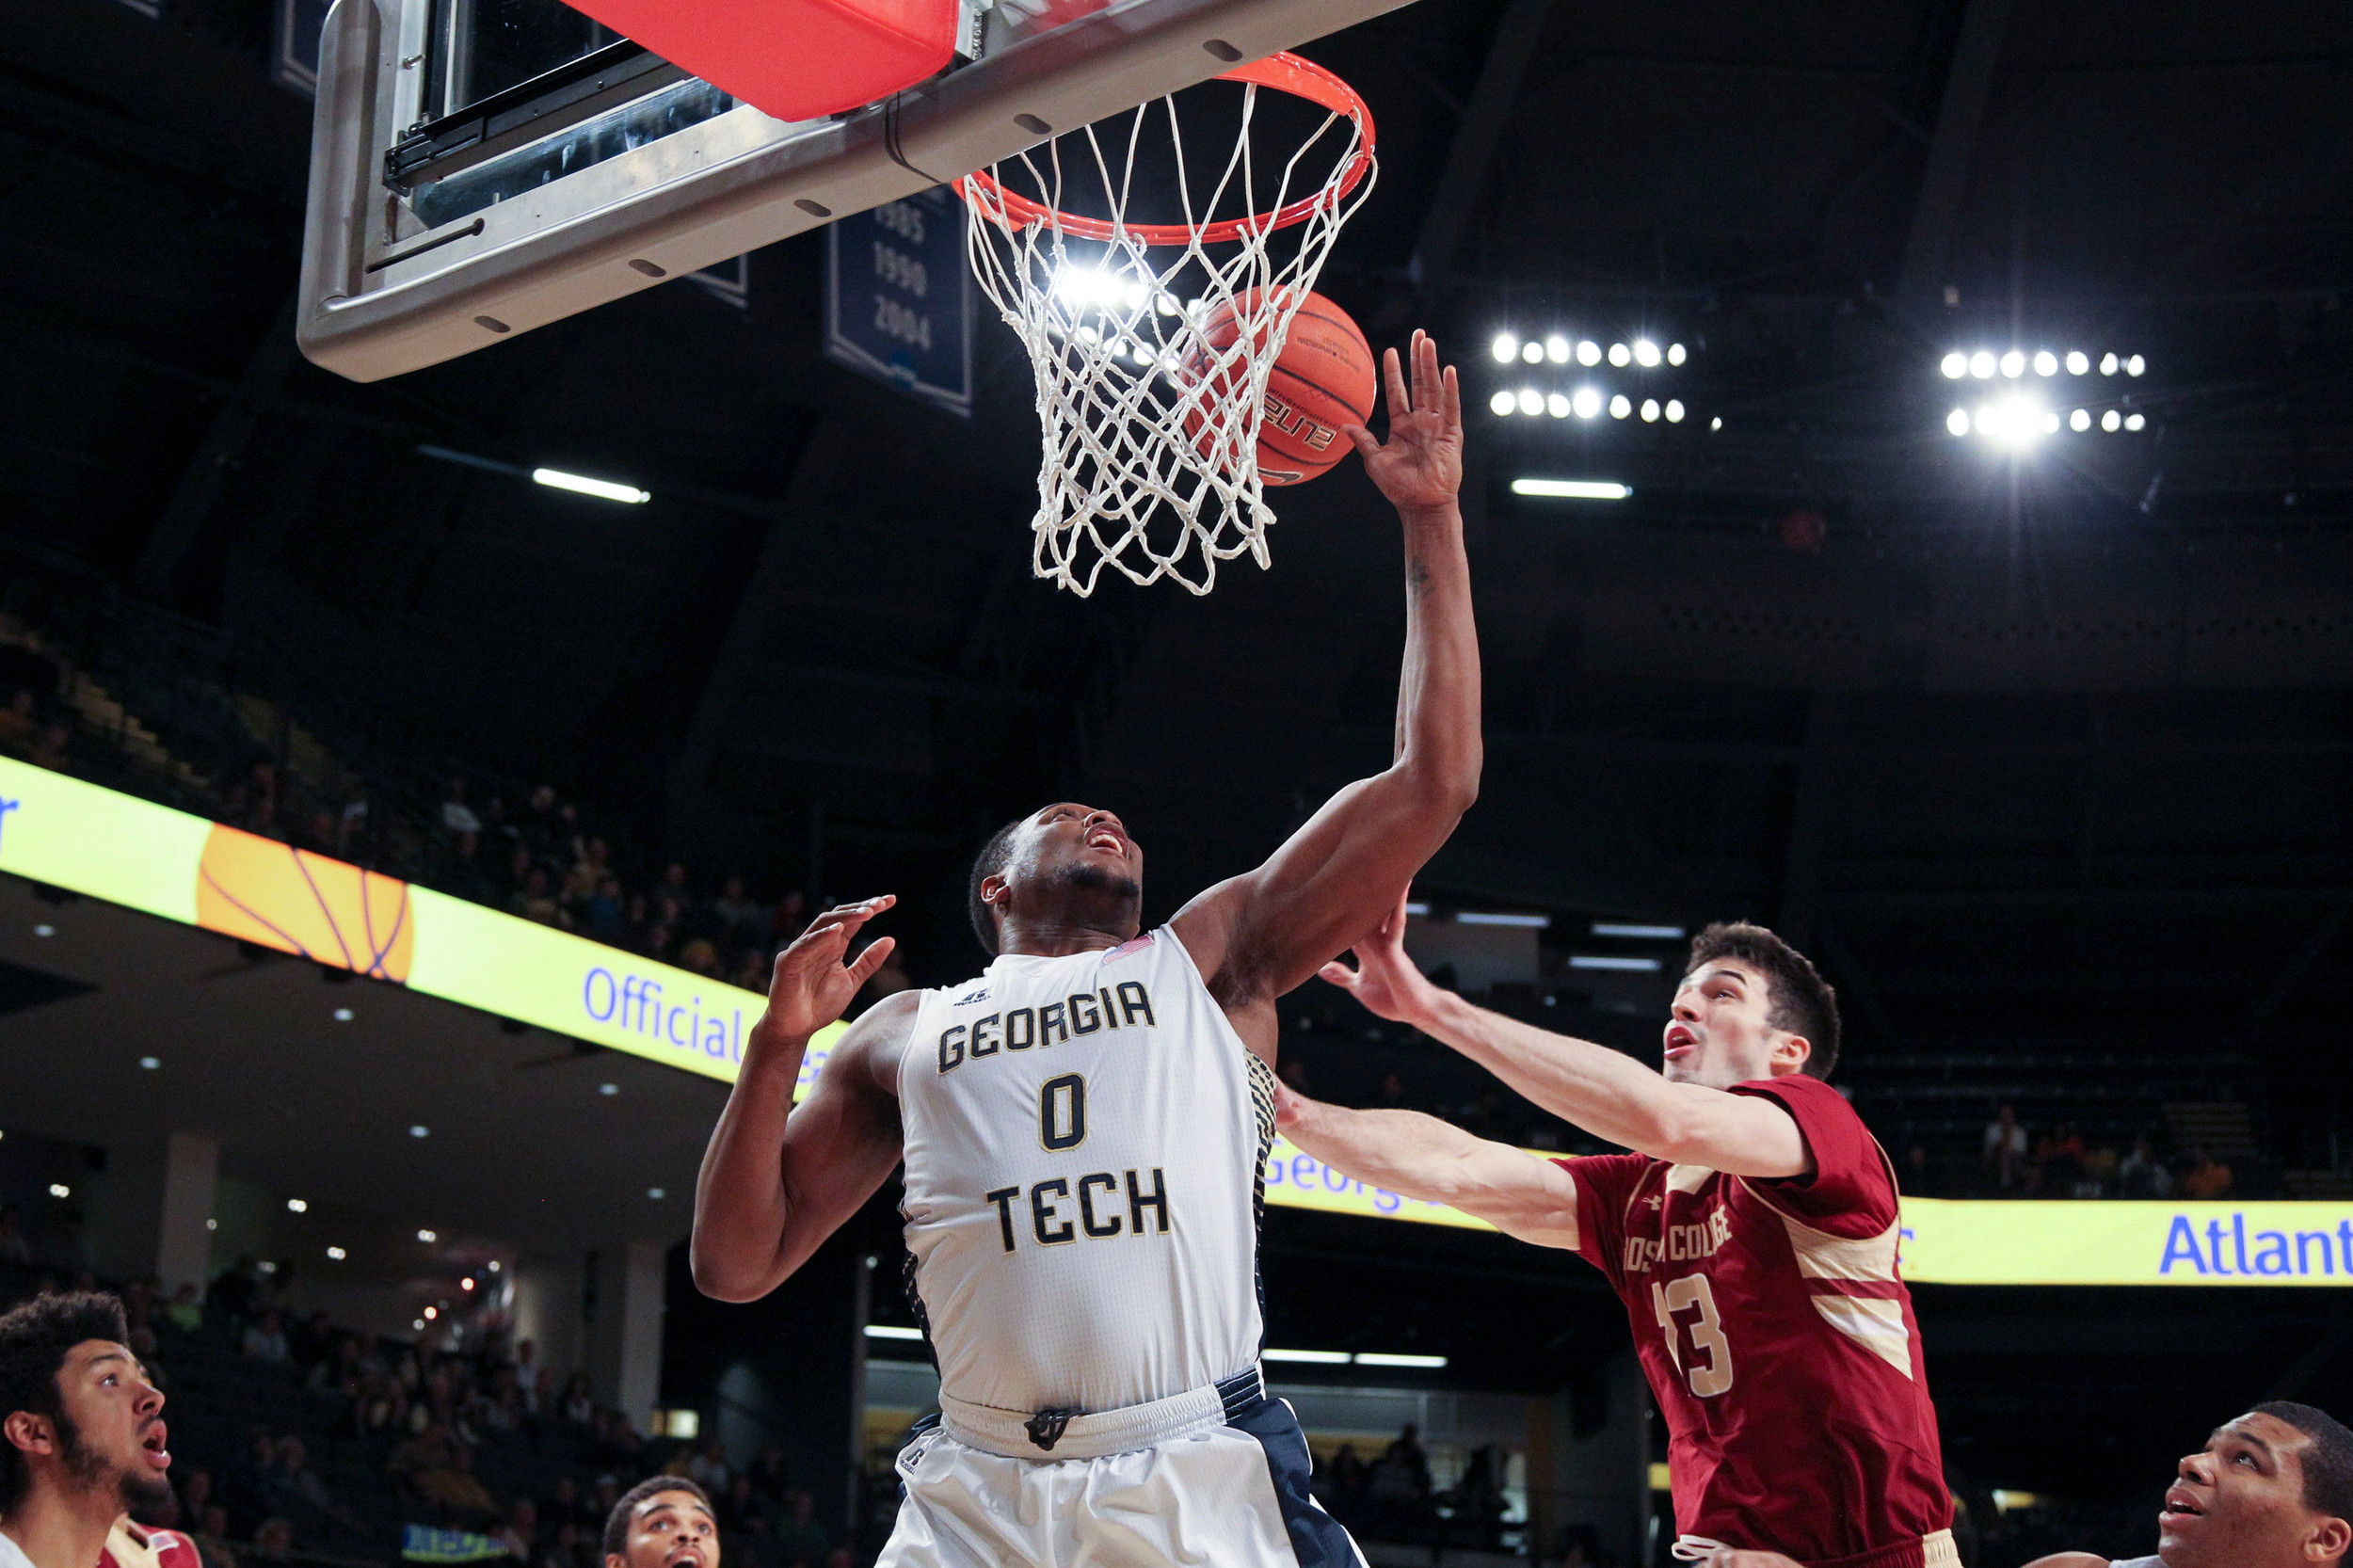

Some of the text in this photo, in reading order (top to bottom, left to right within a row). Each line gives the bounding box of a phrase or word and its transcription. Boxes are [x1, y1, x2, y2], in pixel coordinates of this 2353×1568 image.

[1262, 392, 1337, 452] ELITE
[584, 967, 743, 1064] Official
[937, 981, 1158, 1075] GEORGIA
[1038, 1071, 1088, 1155] 0
[985, 1167, 1171, 1256] TECH
[1651, 1272, 1734, 1398] 13
